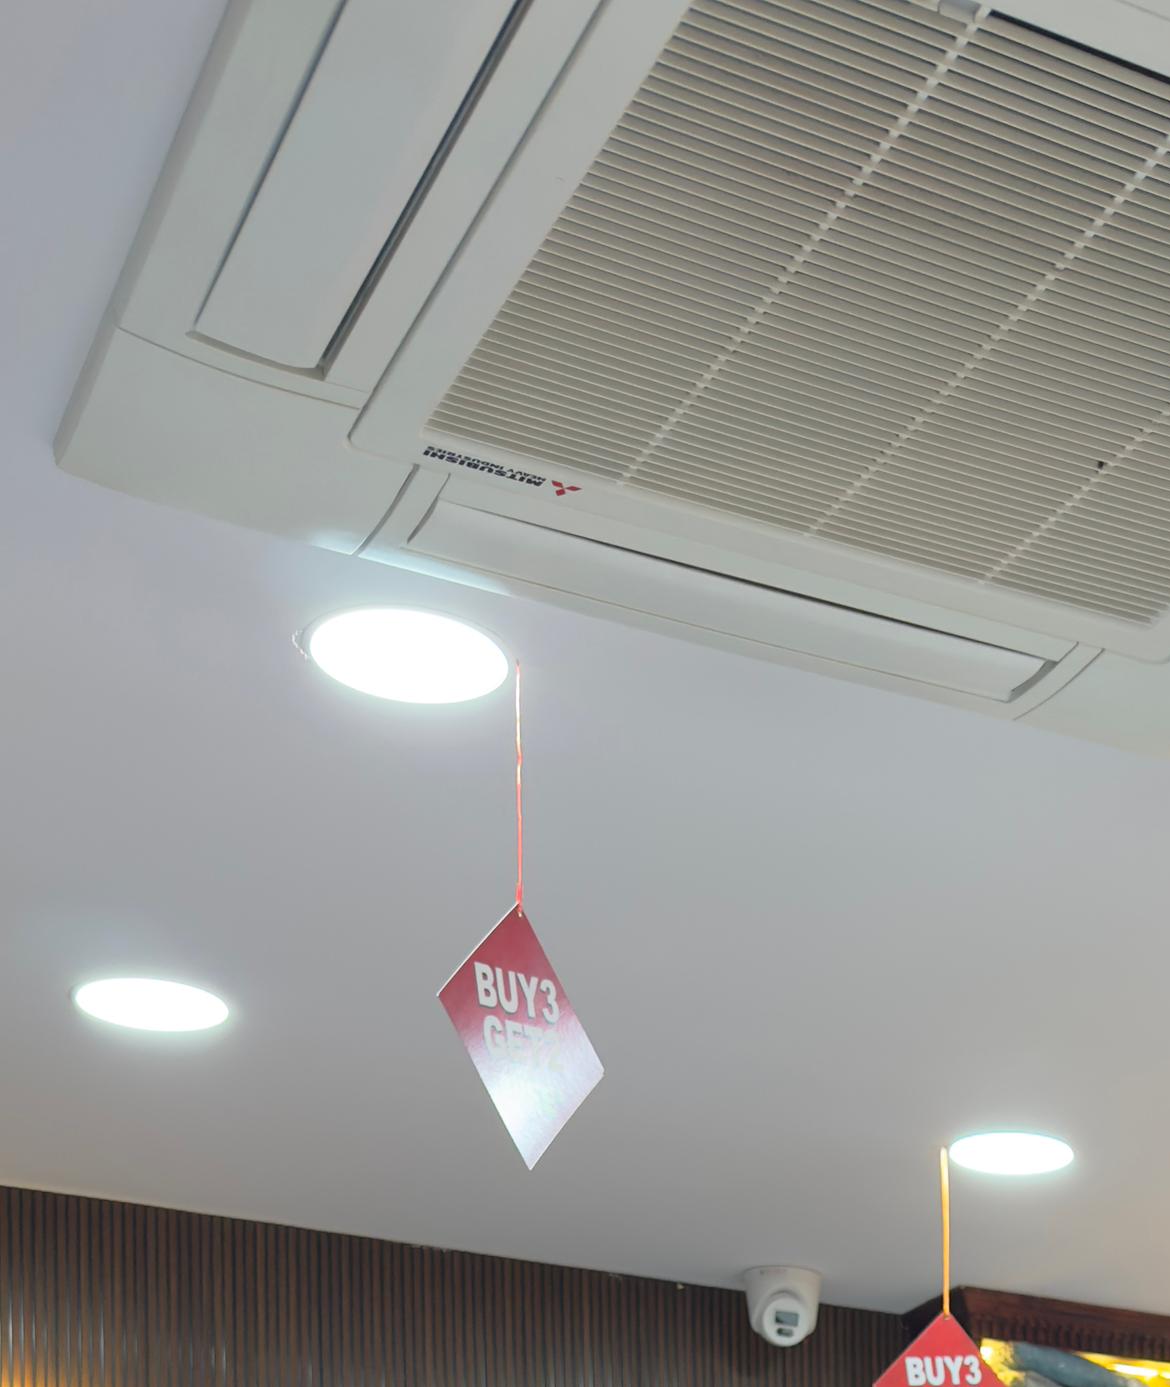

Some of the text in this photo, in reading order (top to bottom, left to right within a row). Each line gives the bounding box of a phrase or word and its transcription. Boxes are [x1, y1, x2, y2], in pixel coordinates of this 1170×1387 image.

[422, 448, 544, 487] MITSUBISHI
[426, 445, 547, 482] HEAVY INDUSTRIES
[474, 961, 561, 1025] BUY3
[905, 1355, 982, 1387] BUY3
